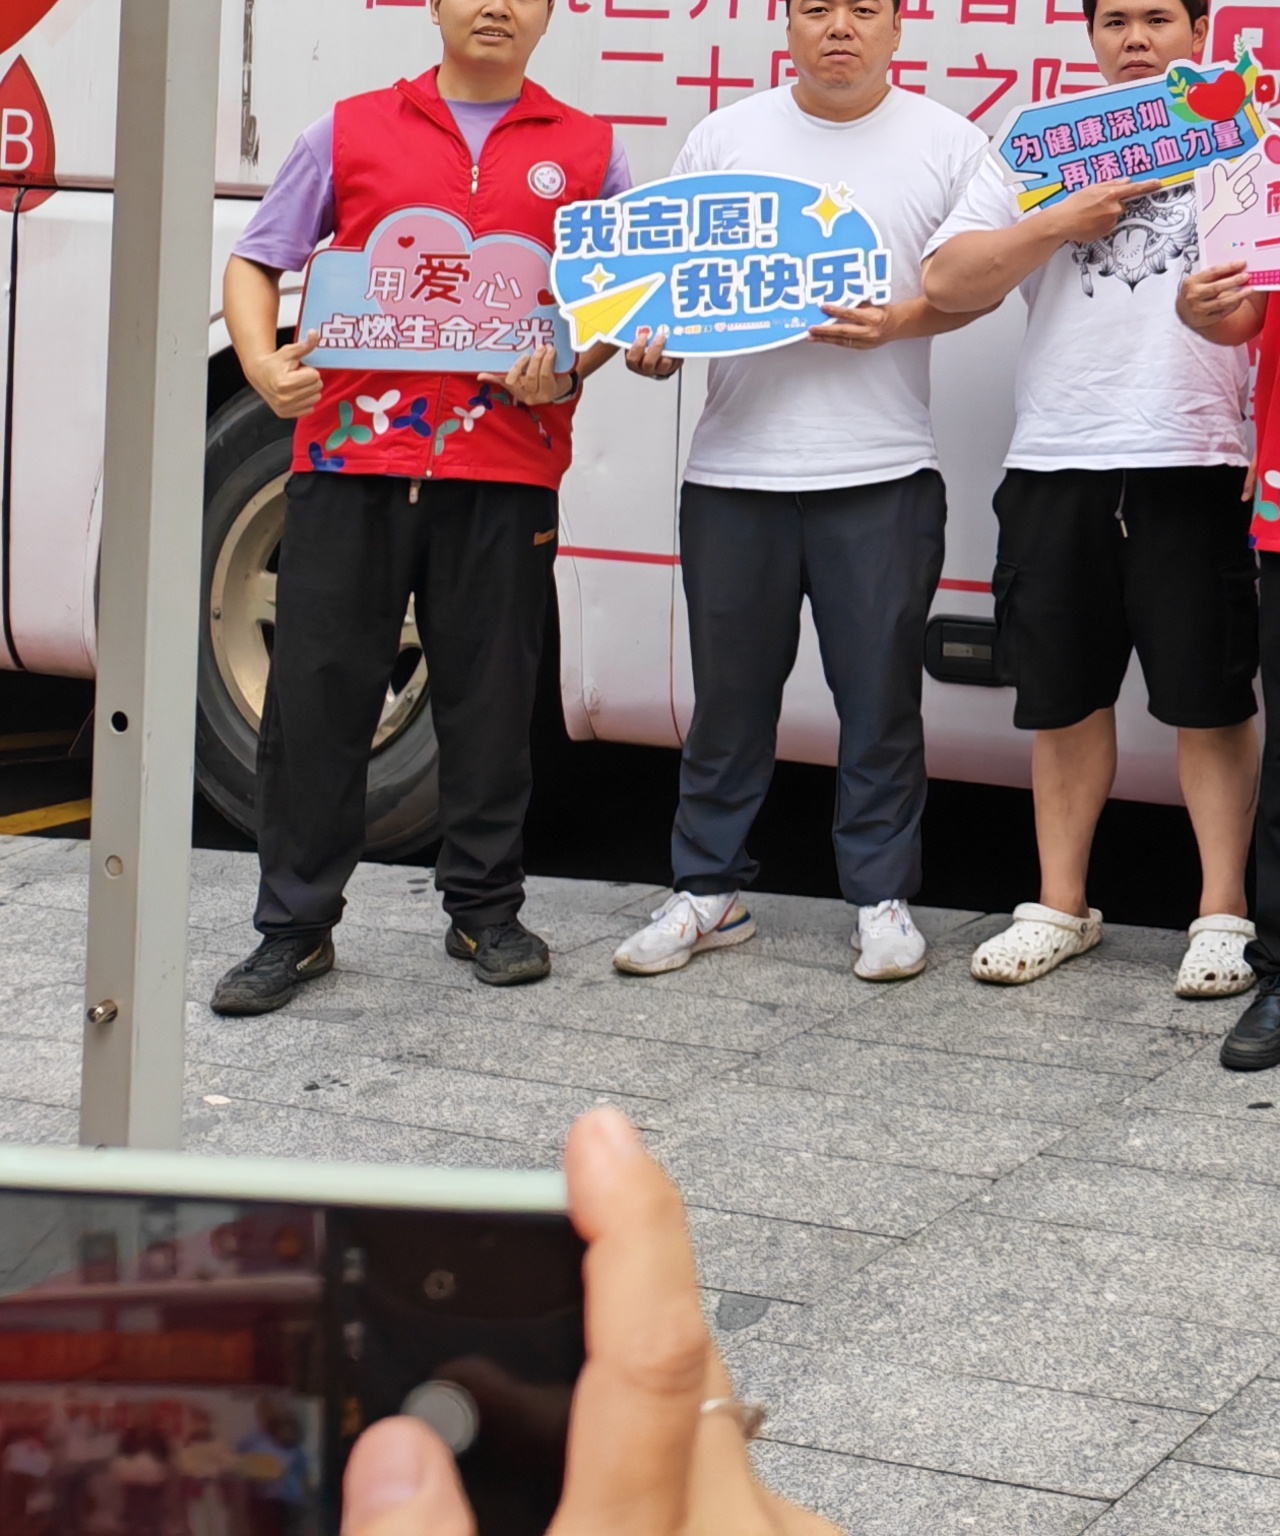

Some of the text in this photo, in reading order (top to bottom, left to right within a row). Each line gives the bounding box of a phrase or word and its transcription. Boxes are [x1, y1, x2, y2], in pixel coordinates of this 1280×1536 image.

[0, 108, 33, 171] B
[1012, 97, 1170, 165] 为健康深圳
[1061, 119, 1244, 192] 再添热血力量
[364, 252, 522, 310] 用爱心
[317, 314, 554, 351] 点燃生命之光
